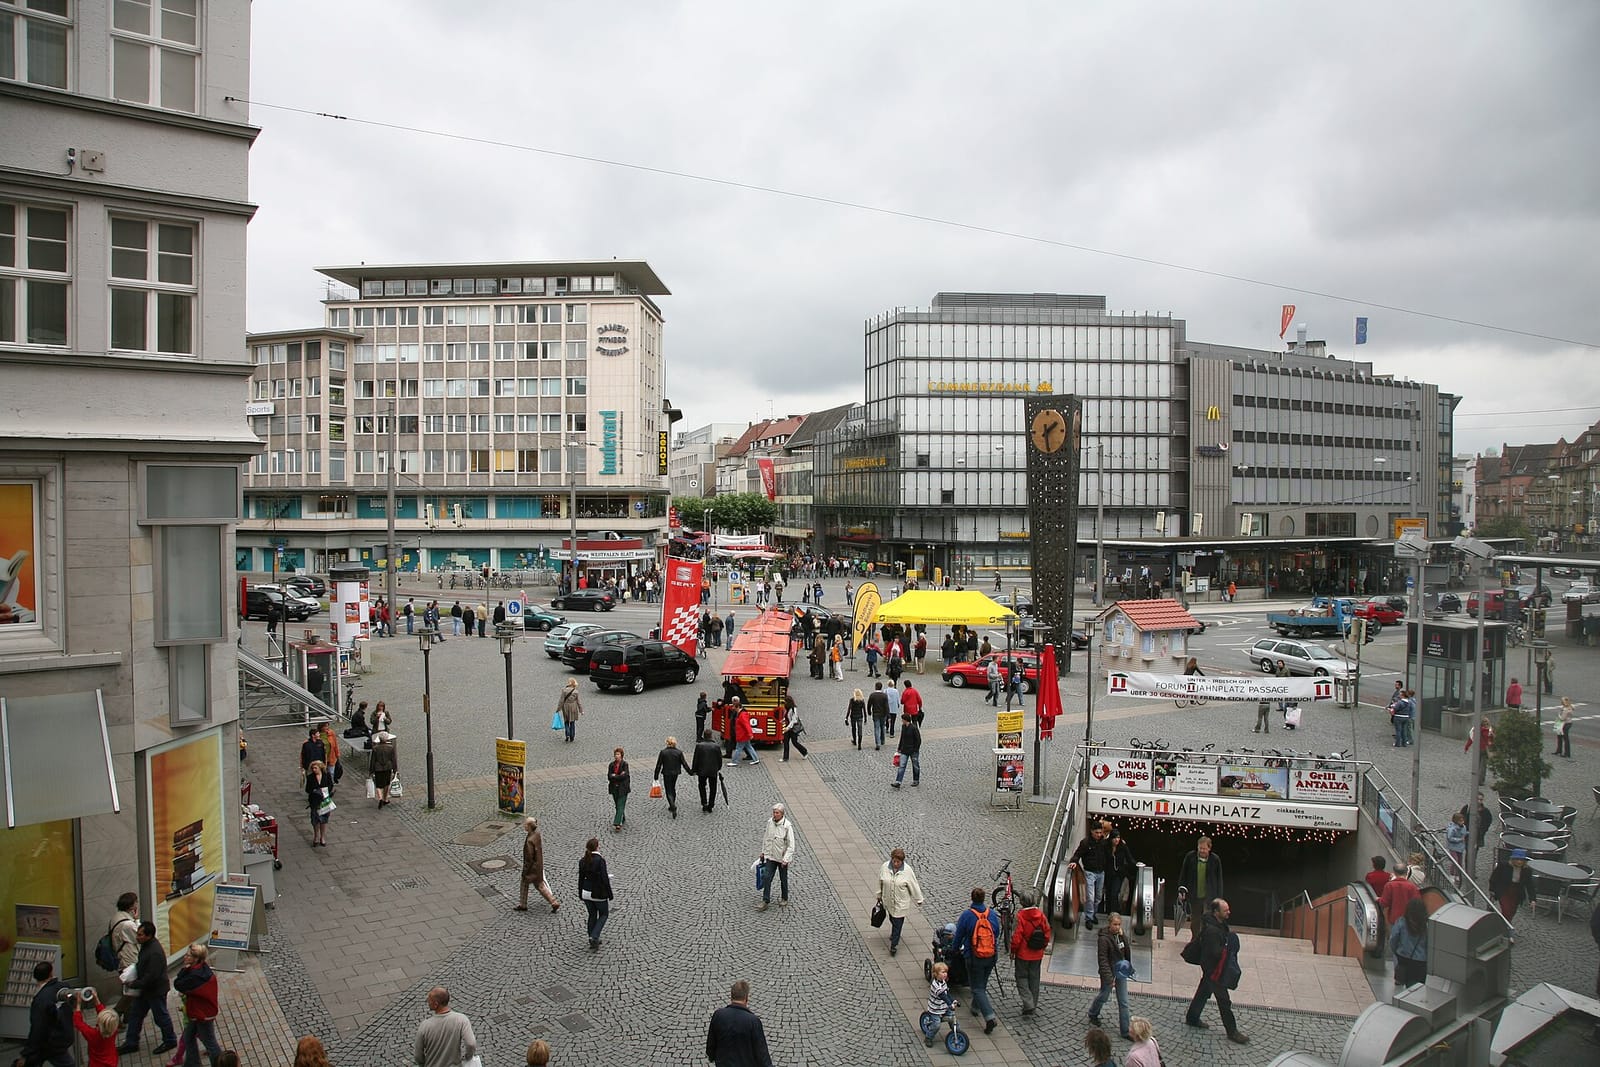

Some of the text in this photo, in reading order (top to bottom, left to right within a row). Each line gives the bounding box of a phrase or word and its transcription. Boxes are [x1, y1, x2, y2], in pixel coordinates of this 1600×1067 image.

[596, 324, 629, 335] DAMEN
[598, 336, 627, 344] FITNESS
[927, 381, 1031, 392] COMMERZBANK
[599, 410, 617, 475] boulevard
[670, 580, 696, 588] SEAT
[1156, 682, 1289, 694] FORUM JAHNPLATZ PASSAGE
[1118, 760, 1146, 770] CHINA
[1115, 770, 1149, 781] IMBISS
[1309, 771, 1336, 781] Grill
[1295, 780, 1350, 791] ANTALYA
[1101, 797, 1261, 819] FORUM JAHNPLATZ
[1276, 807, 1305, 815] einkaufen
[1294, 813, 1324, 821] verweilen
